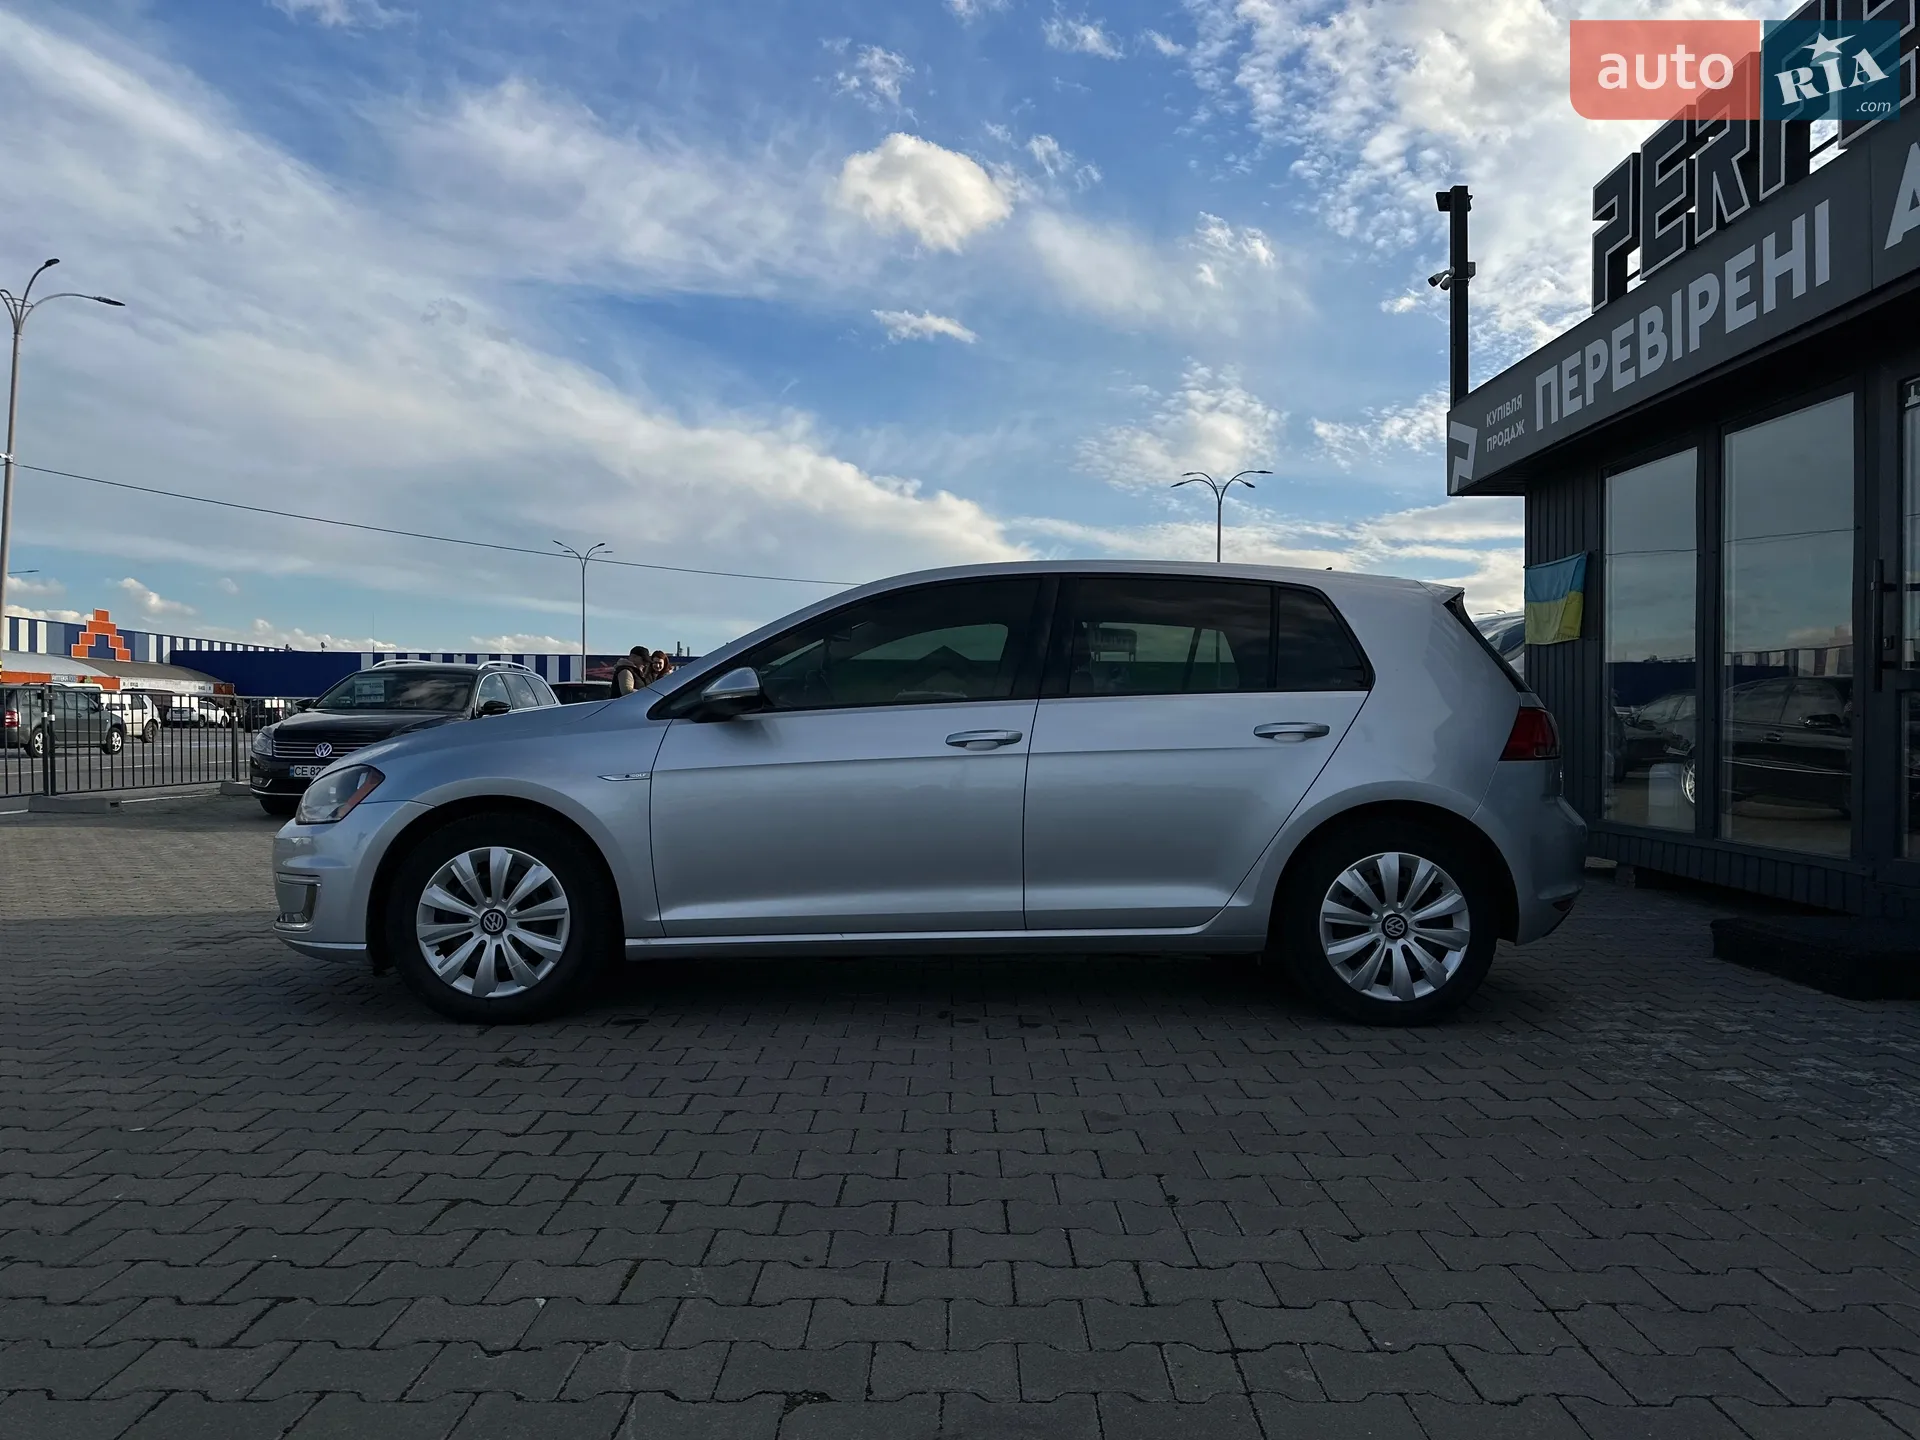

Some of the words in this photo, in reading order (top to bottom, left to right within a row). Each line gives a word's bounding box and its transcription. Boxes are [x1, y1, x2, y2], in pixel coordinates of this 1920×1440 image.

[1536, 198, 1830, 431] ПЕРЕВІРЕНІ
[1486, 393, 1523, 427] КУПІВЛЯ
[1486, 418, 1525, 453] ПРОДАЖ
[294, 766, 308, 776] CE
